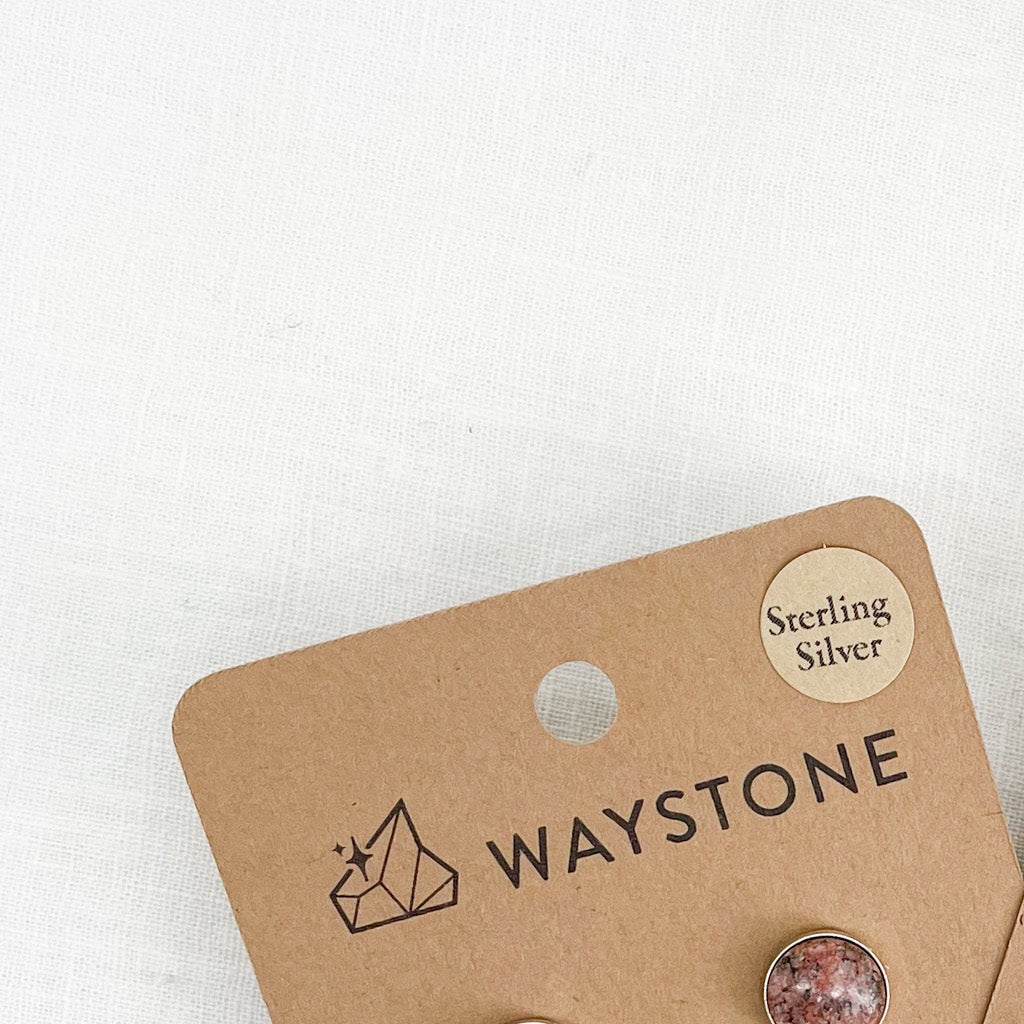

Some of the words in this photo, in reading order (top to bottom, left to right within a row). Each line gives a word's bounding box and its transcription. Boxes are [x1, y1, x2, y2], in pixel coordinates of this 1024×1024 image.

[766, 594, 892, 637] Sterling
[795, 635, 883, 672] Silver
[485, 728, 909, 890] WAYSTONE
